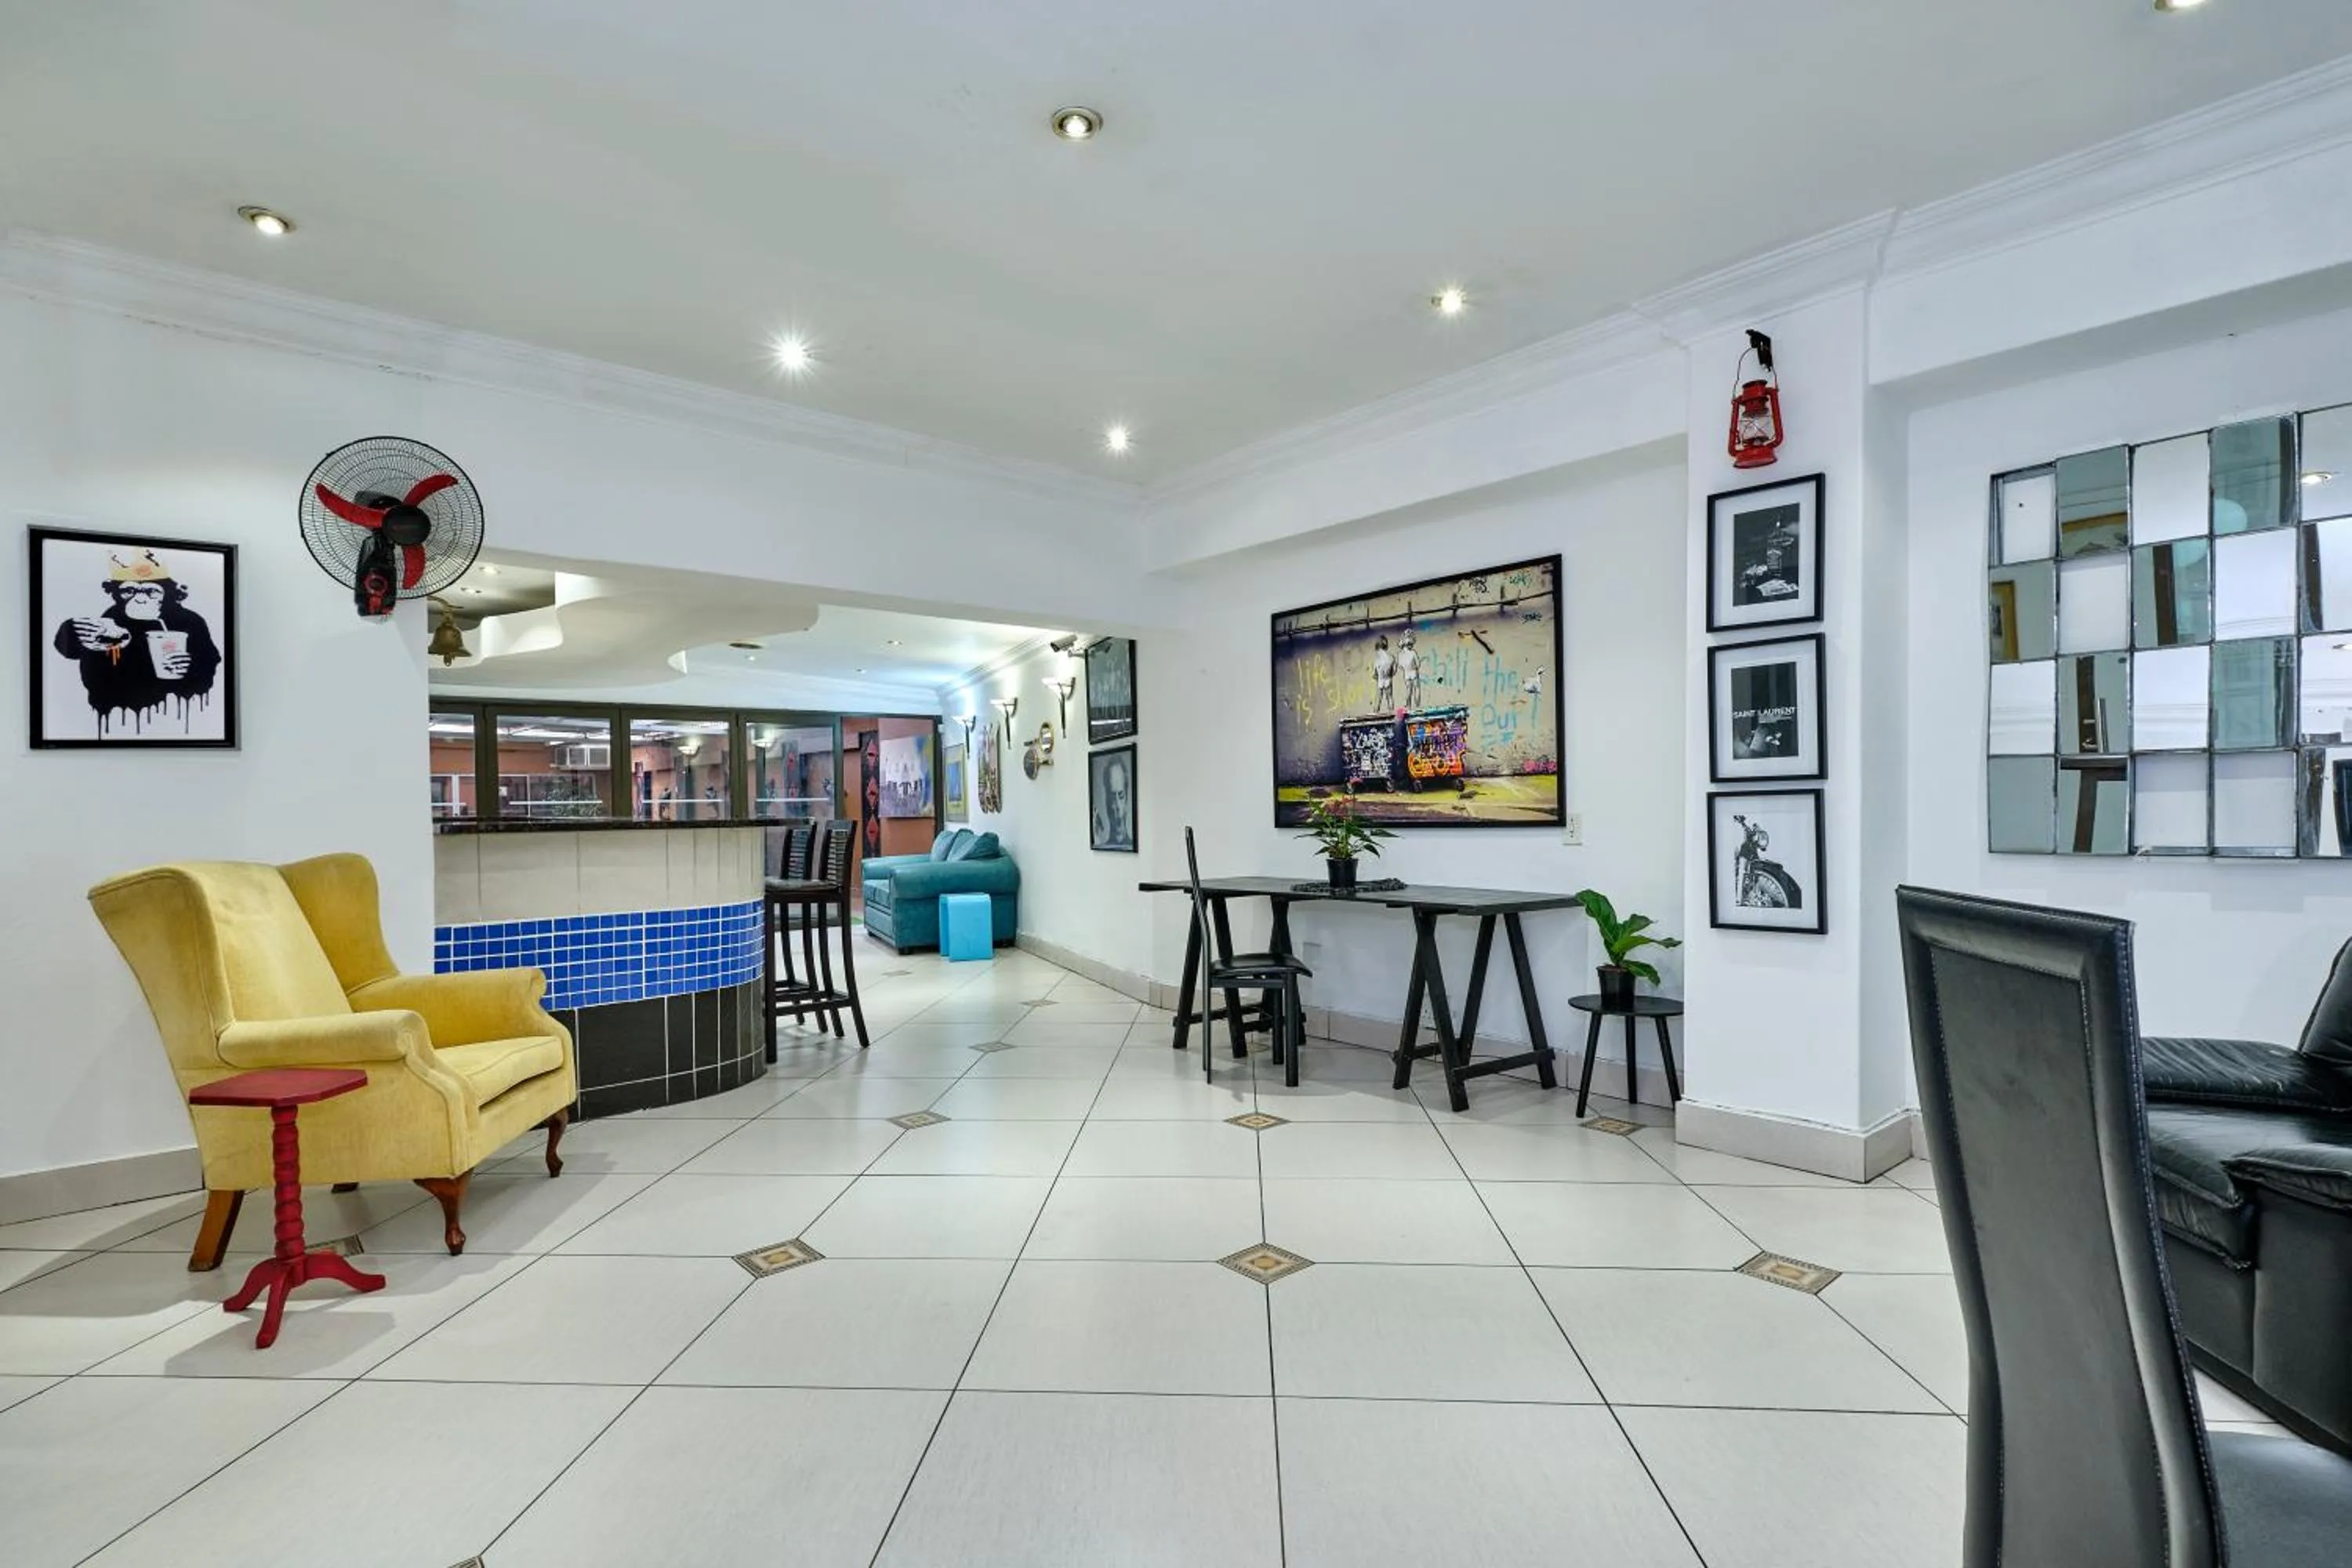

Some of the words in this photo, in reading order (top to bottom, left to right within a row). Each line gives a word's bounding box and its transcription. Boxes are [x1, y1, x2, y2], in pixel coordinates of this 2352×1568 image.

[1297, 653, 1329, 698] life
[1482, 655, 1519, 702] the
[1297, 694, 1313, 732] is
[1733, 710, 1756, 720] SAINT
[1757, 706, 1795, 717] LAURENT
